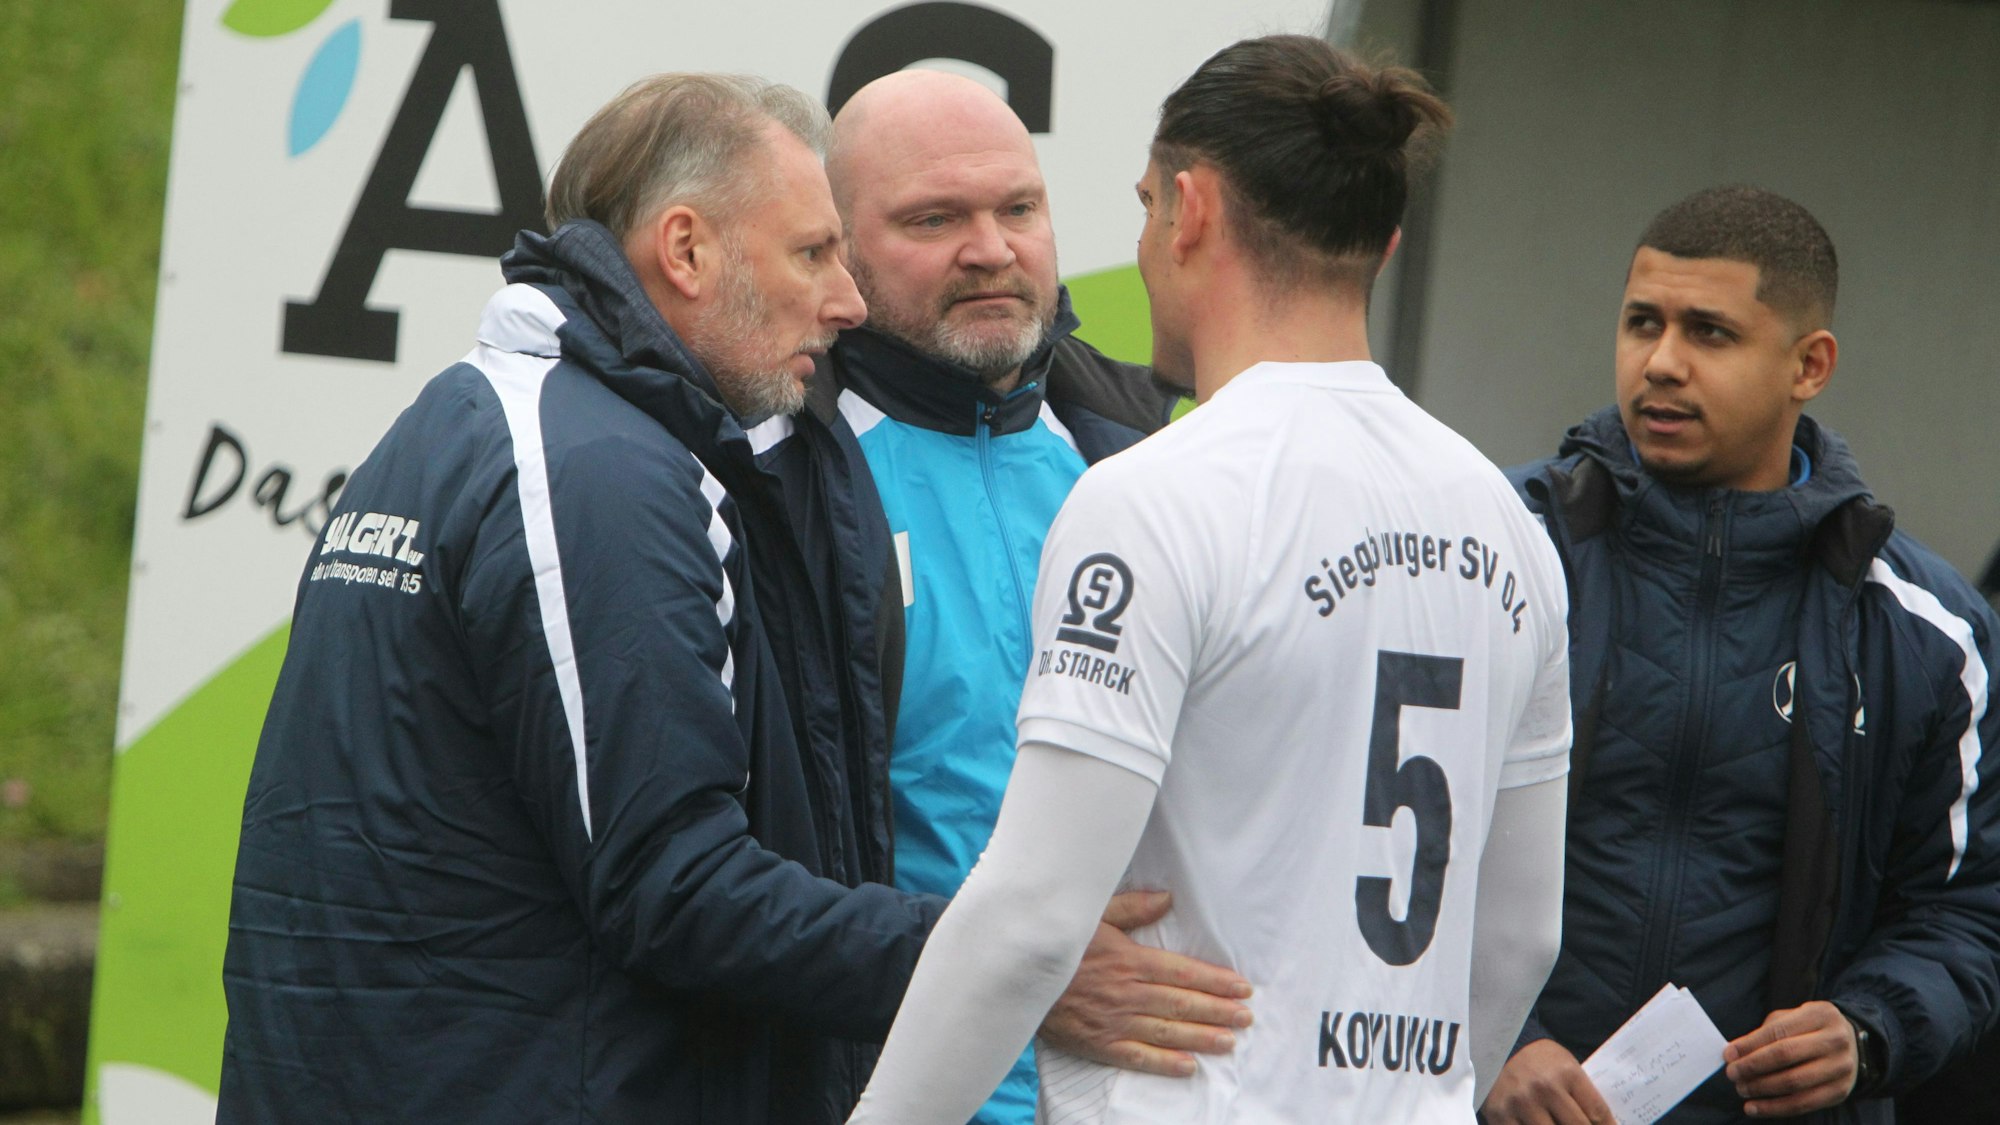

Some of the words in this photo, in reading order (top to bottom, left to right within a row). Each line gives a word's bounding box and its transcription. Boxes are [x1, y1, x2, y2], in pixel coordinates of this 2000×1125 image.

[1459, 536, 1499, 589] SV
[1055, 649, 1136, 695] STARCK
[1355, 649, 1465, 967] 5
